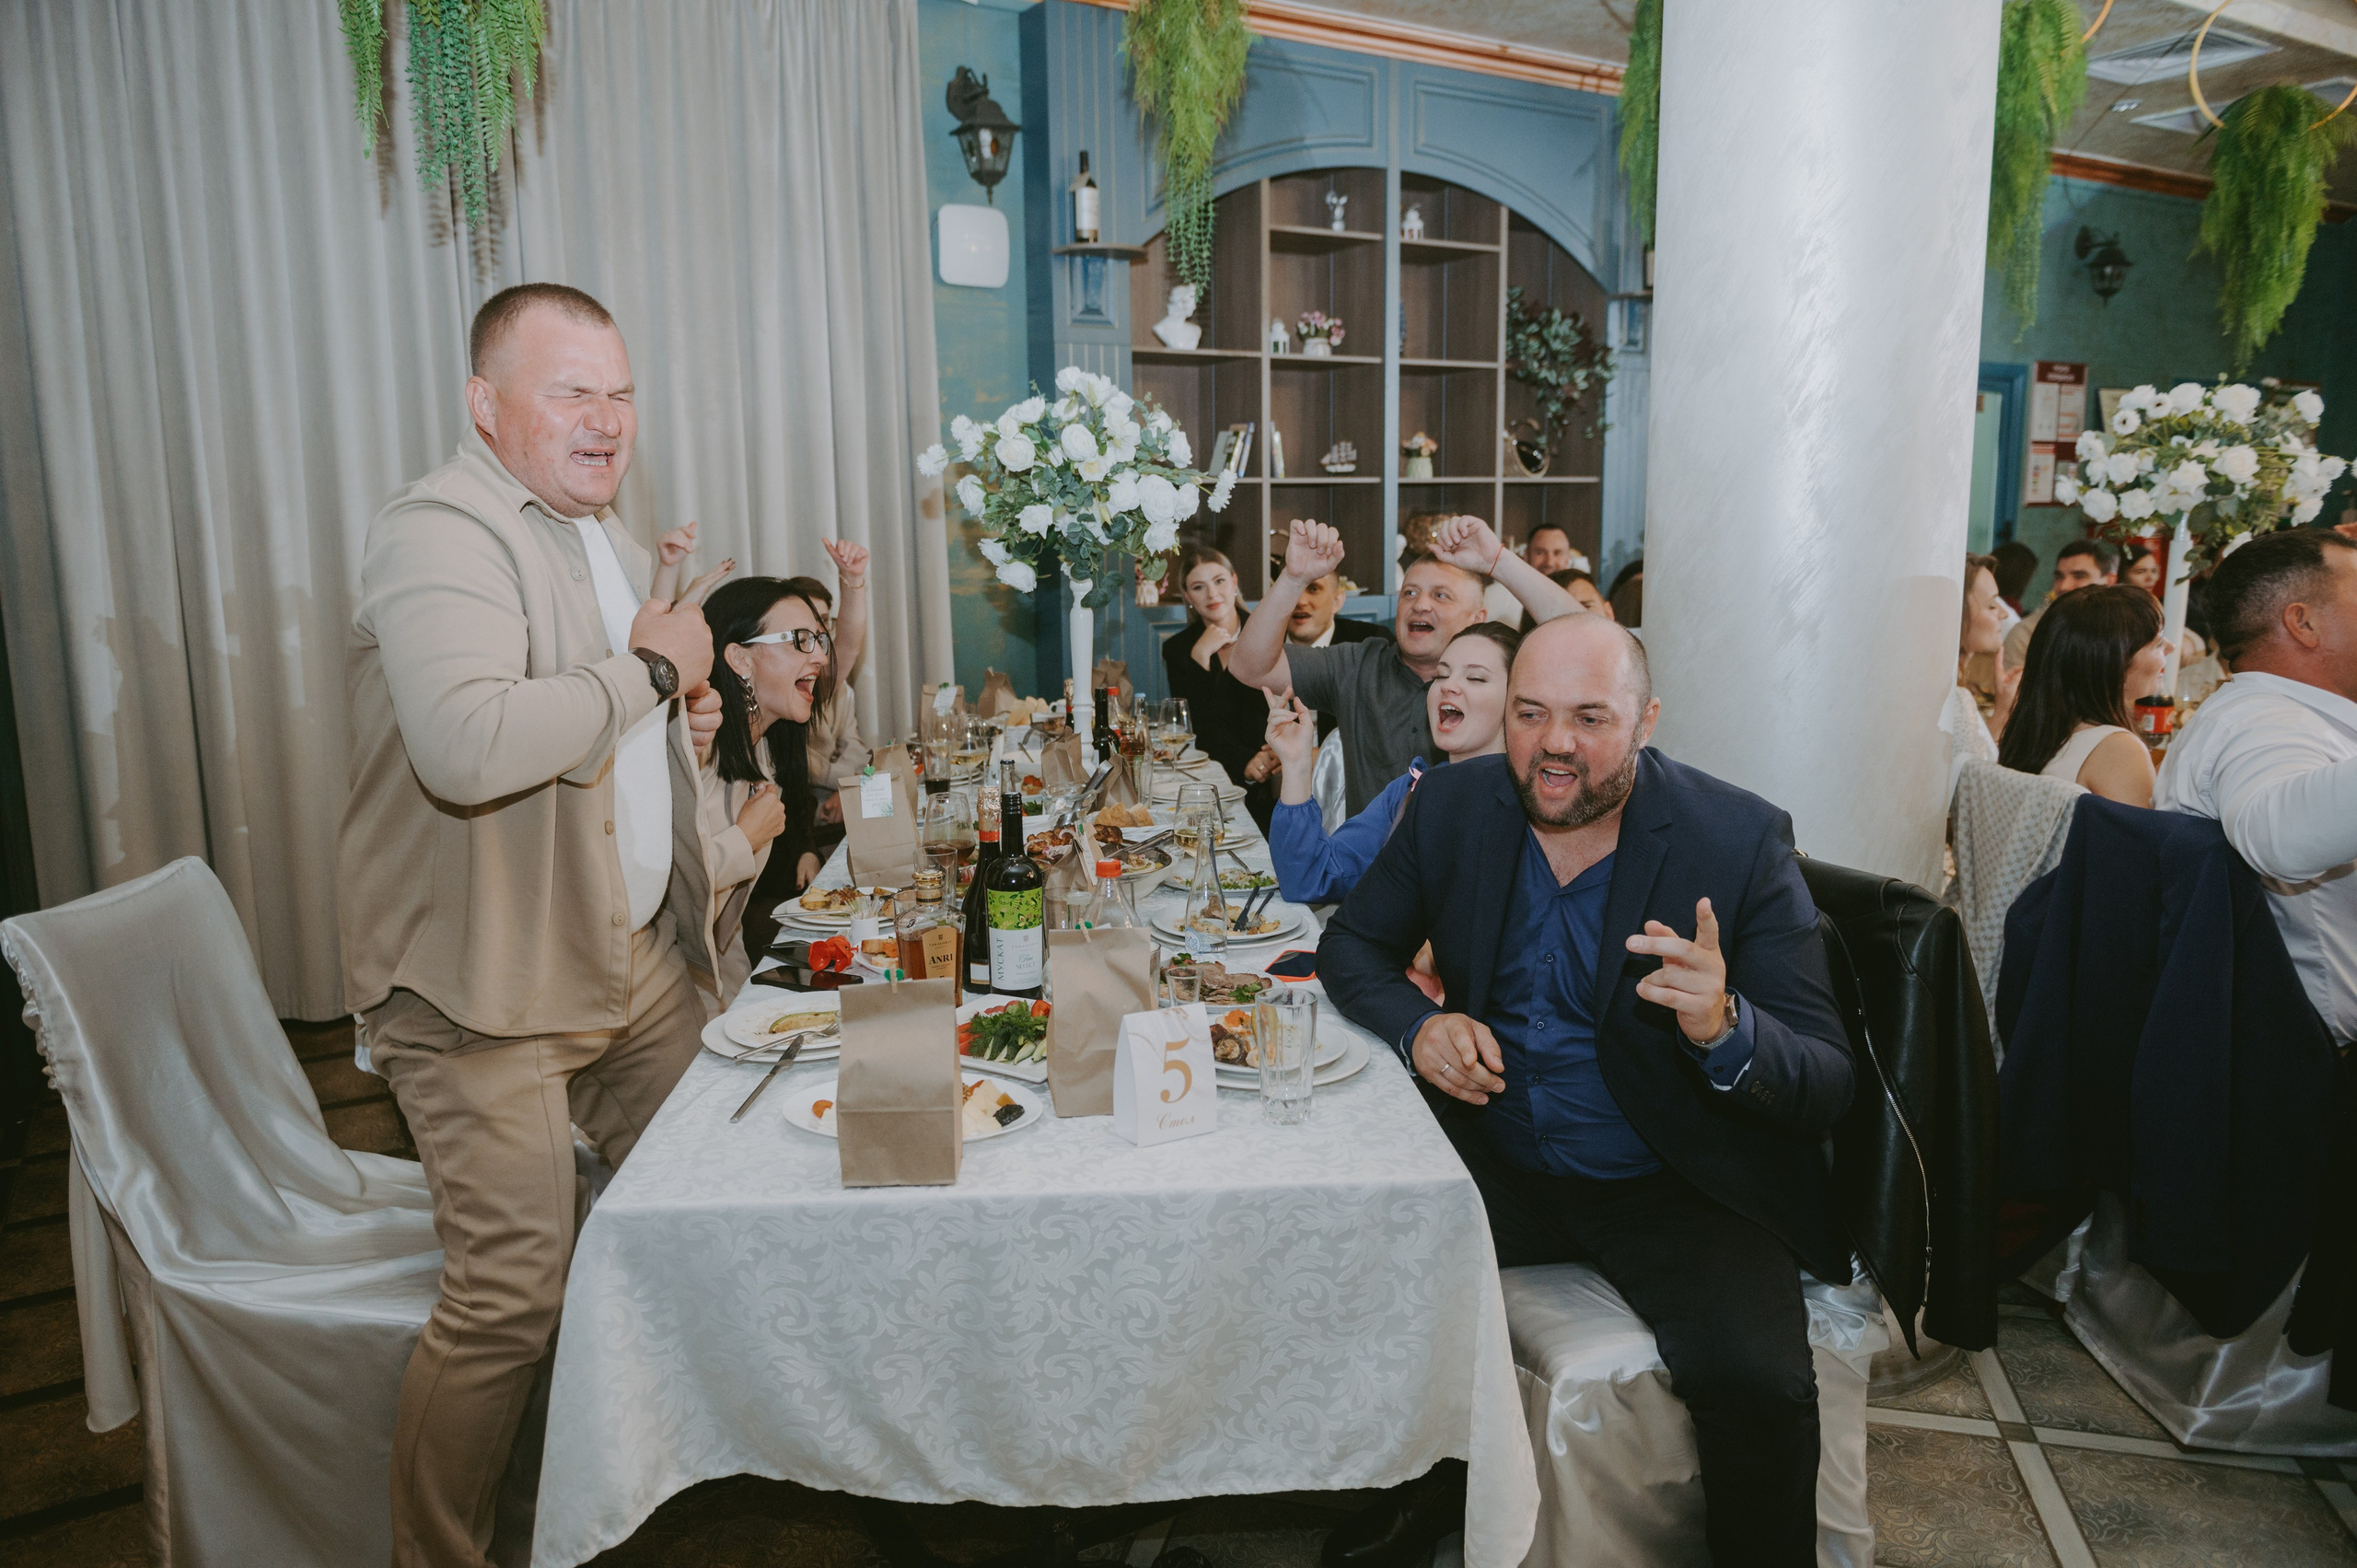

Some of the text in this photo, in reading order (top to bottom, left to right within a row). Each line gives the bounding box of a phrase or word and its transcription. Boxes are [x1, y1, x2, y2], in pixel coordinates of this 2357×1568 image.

[929, 953, 953, 965] ANRI
[996, 937, 1004, 981] МУСКАТ
[1160, 1036, 1192, 1104] 5
